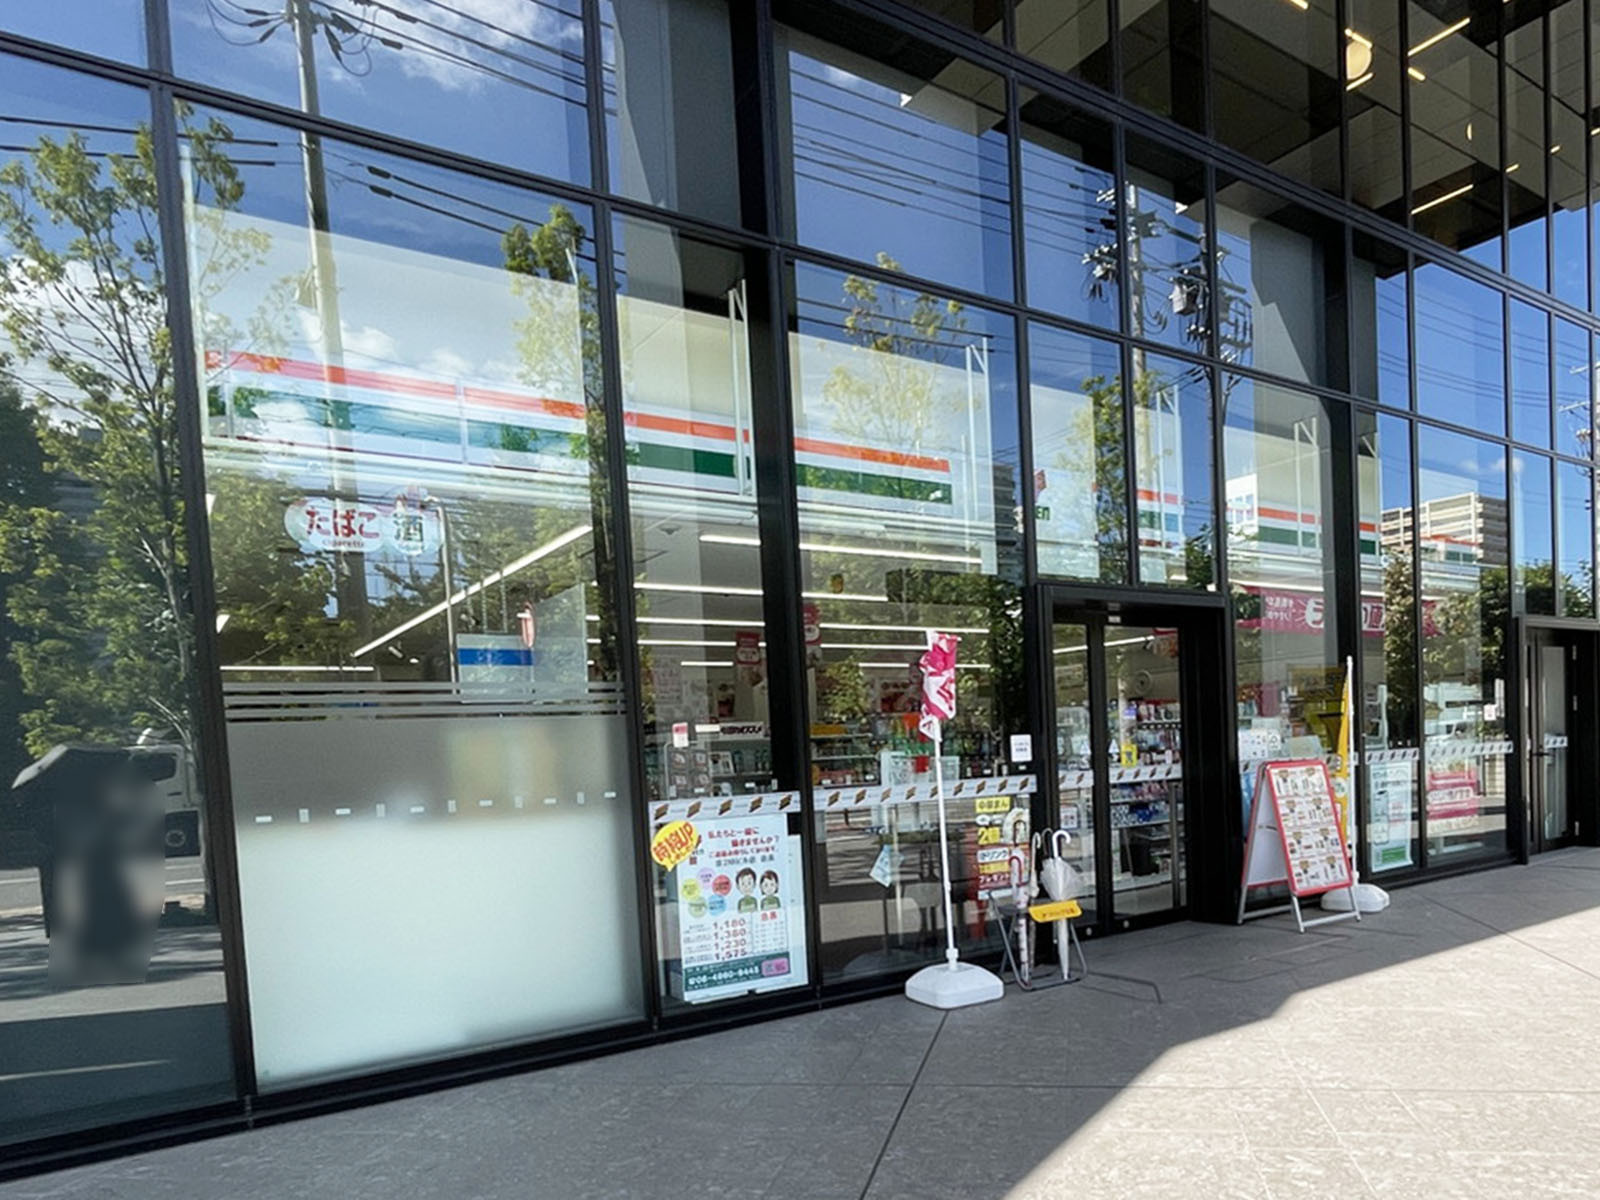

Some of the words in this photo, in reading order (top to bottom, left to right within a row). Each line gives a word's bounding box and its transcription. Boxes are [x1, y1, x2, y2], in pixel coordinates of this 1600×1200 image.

[306, 508, 380, 538] たばこ
[393, 511, 424, 542] 酒
[653, 822, 694, 862] 時給UP
